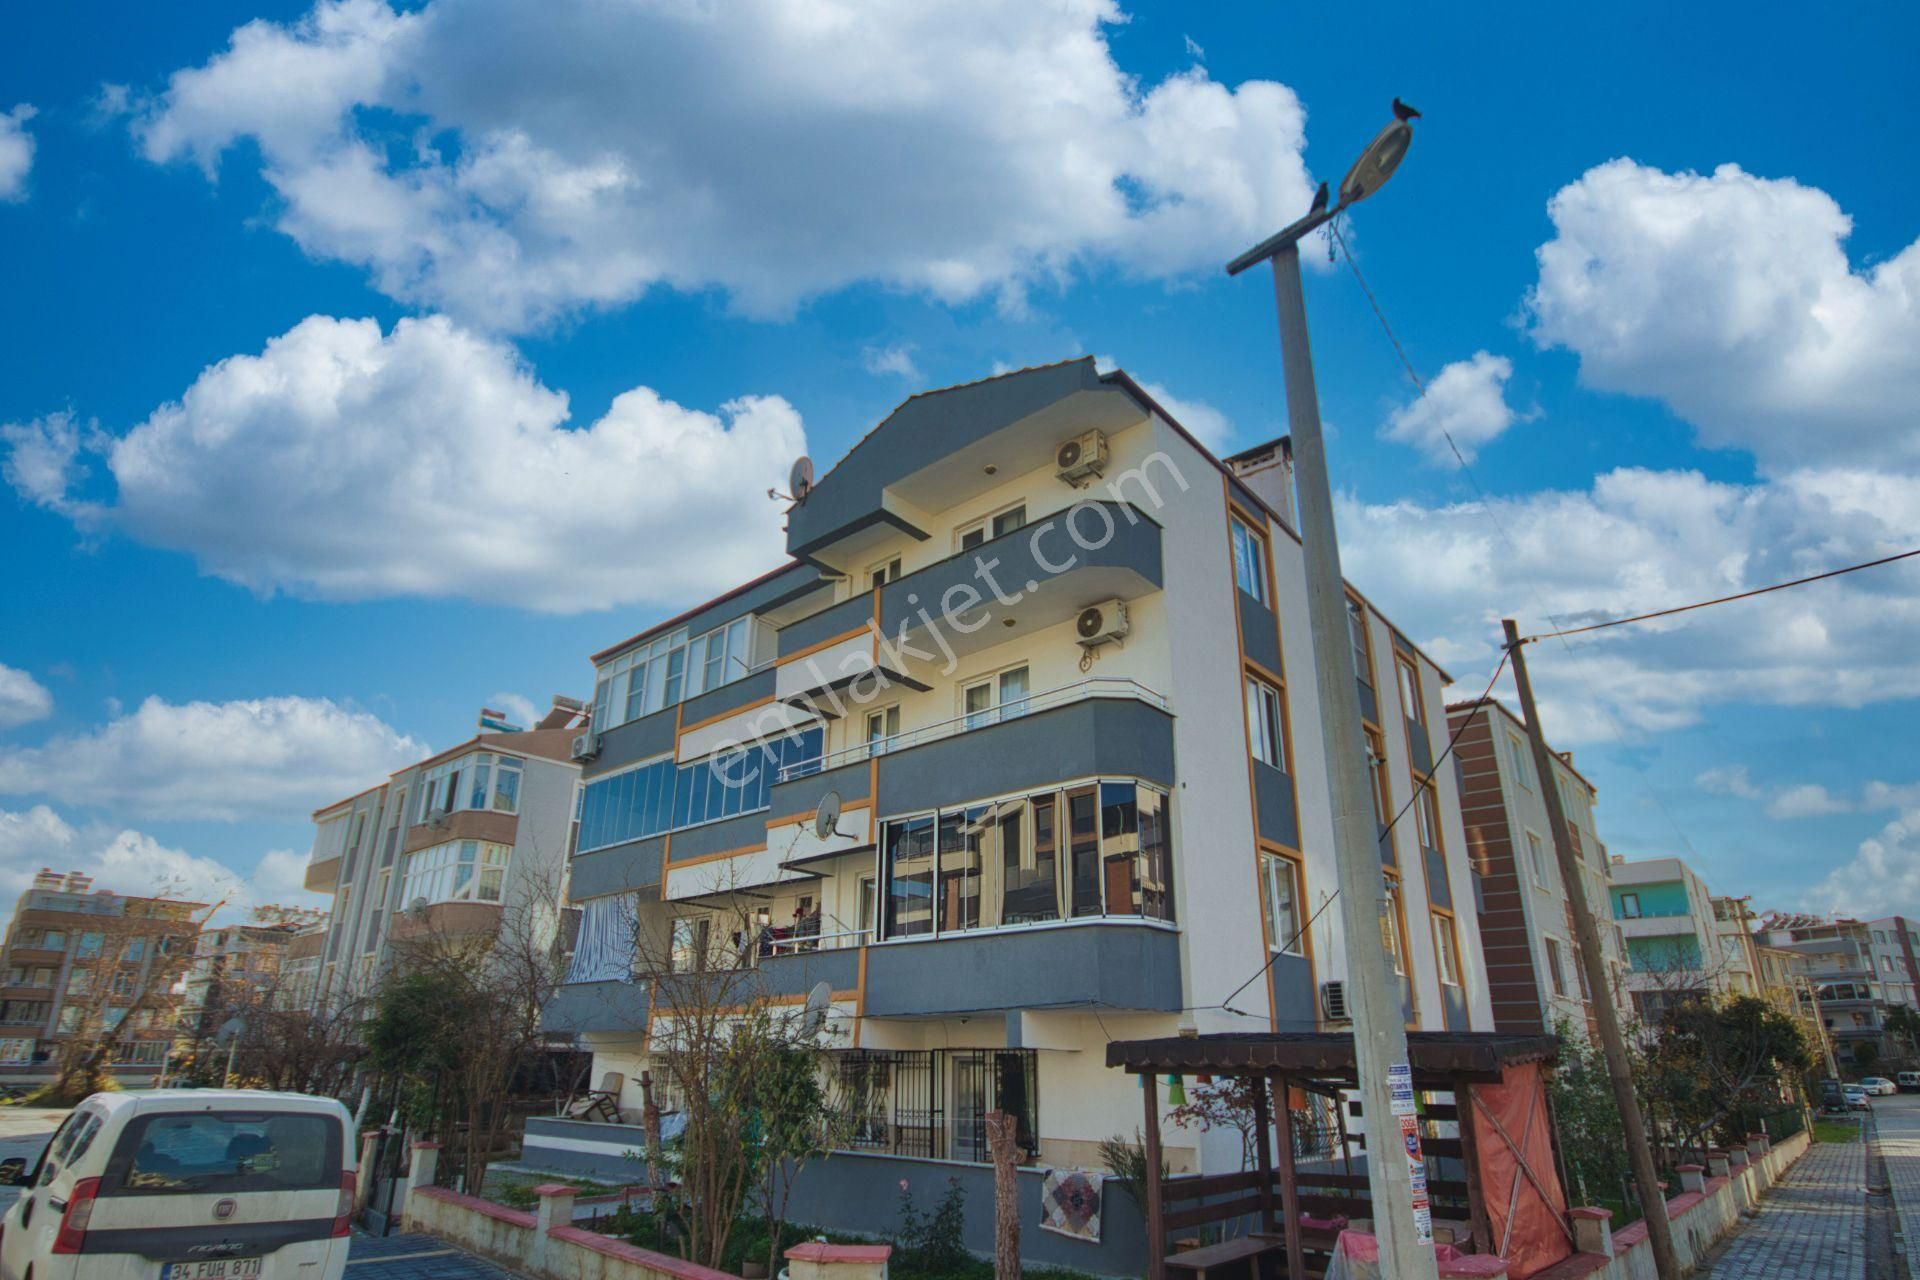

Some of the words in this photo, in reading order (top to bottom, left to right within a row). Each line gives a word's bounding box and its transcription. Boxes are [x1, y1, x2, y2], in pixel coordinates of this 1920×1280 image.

[173, 1264, 191, 1280] 34
[198, 1262, 226, 1277] FUH
[233, 1260, 257, 1275] 871
